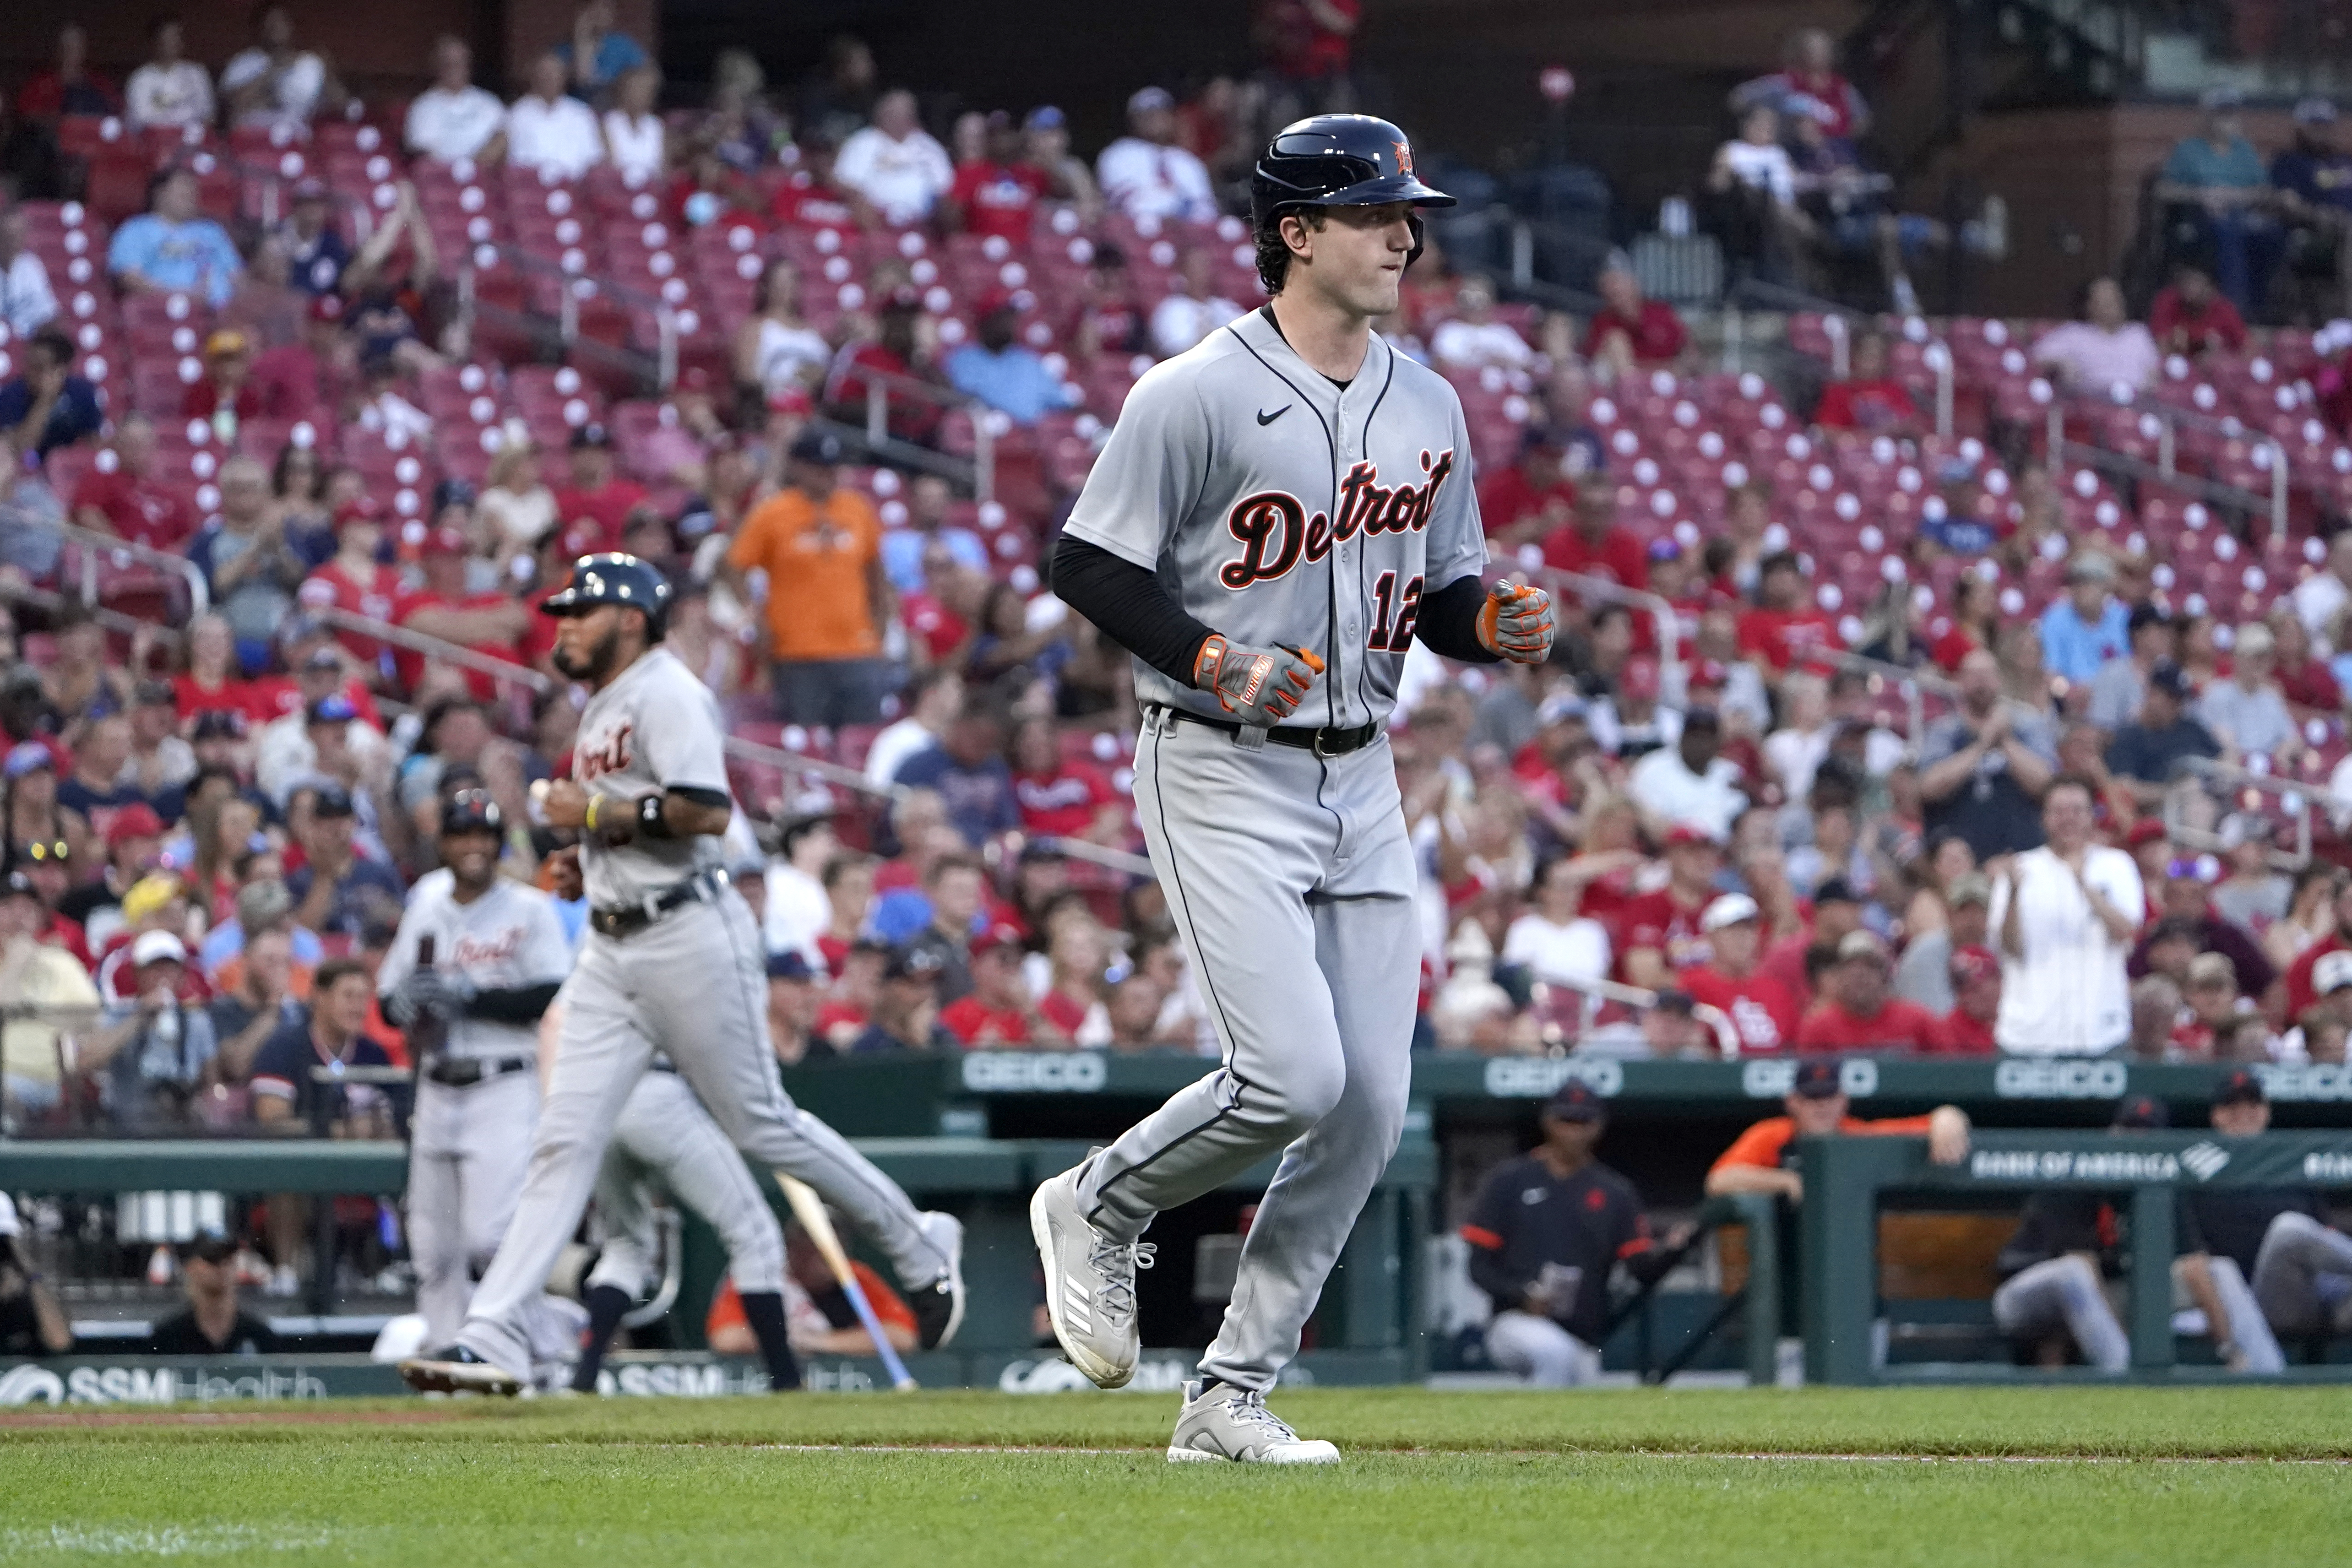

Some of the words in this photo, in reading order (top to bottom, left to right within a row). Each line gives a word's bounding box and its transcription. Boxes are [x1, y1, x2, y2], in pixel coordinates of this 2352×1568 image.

[1219, 447, 1454, 591] Detroit
[1367, 569, 1424, 653] 12
[962, 1051, 1107, 1093] GEICO
[1742, 1058, 1879, 1098] GEO
[1994, 1058, 2127, 1099] GEICO
[68, 1366, 175, 1404] SSM
[176, 1366, 326, 1403] Health
[618, 1363, 723, 1395] SSM
[723, 1361, 873, 1394] Helth
